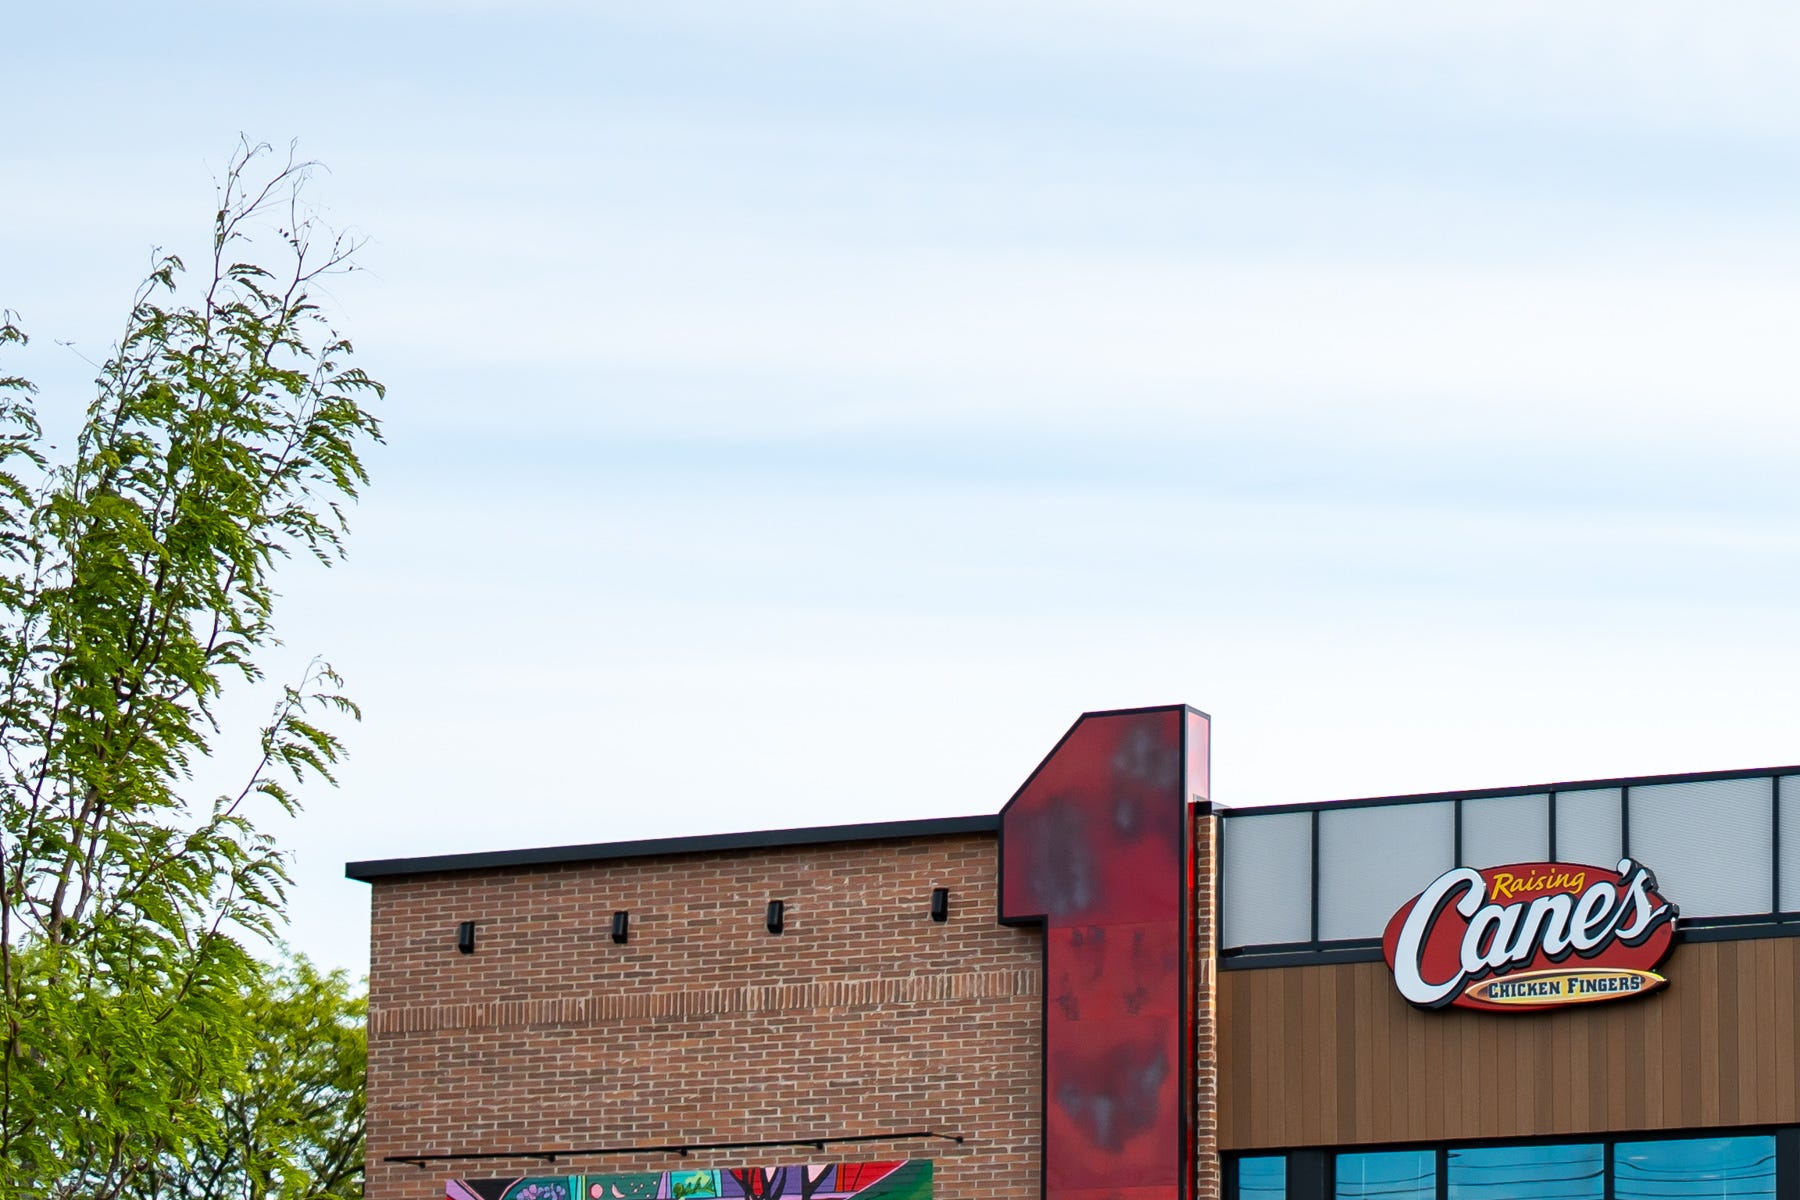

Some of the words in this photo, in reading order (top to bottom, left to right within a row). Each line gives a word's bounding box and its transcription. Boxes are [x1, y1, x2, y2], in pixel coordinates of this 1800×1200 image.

[1490, 868, 1586, 900] Raising
[1394, 857, 1671, 1005] Cane's
[1488, 975, 1561, 999] CHICKEN
[1567, 975, 1641, 994] FINGERS
